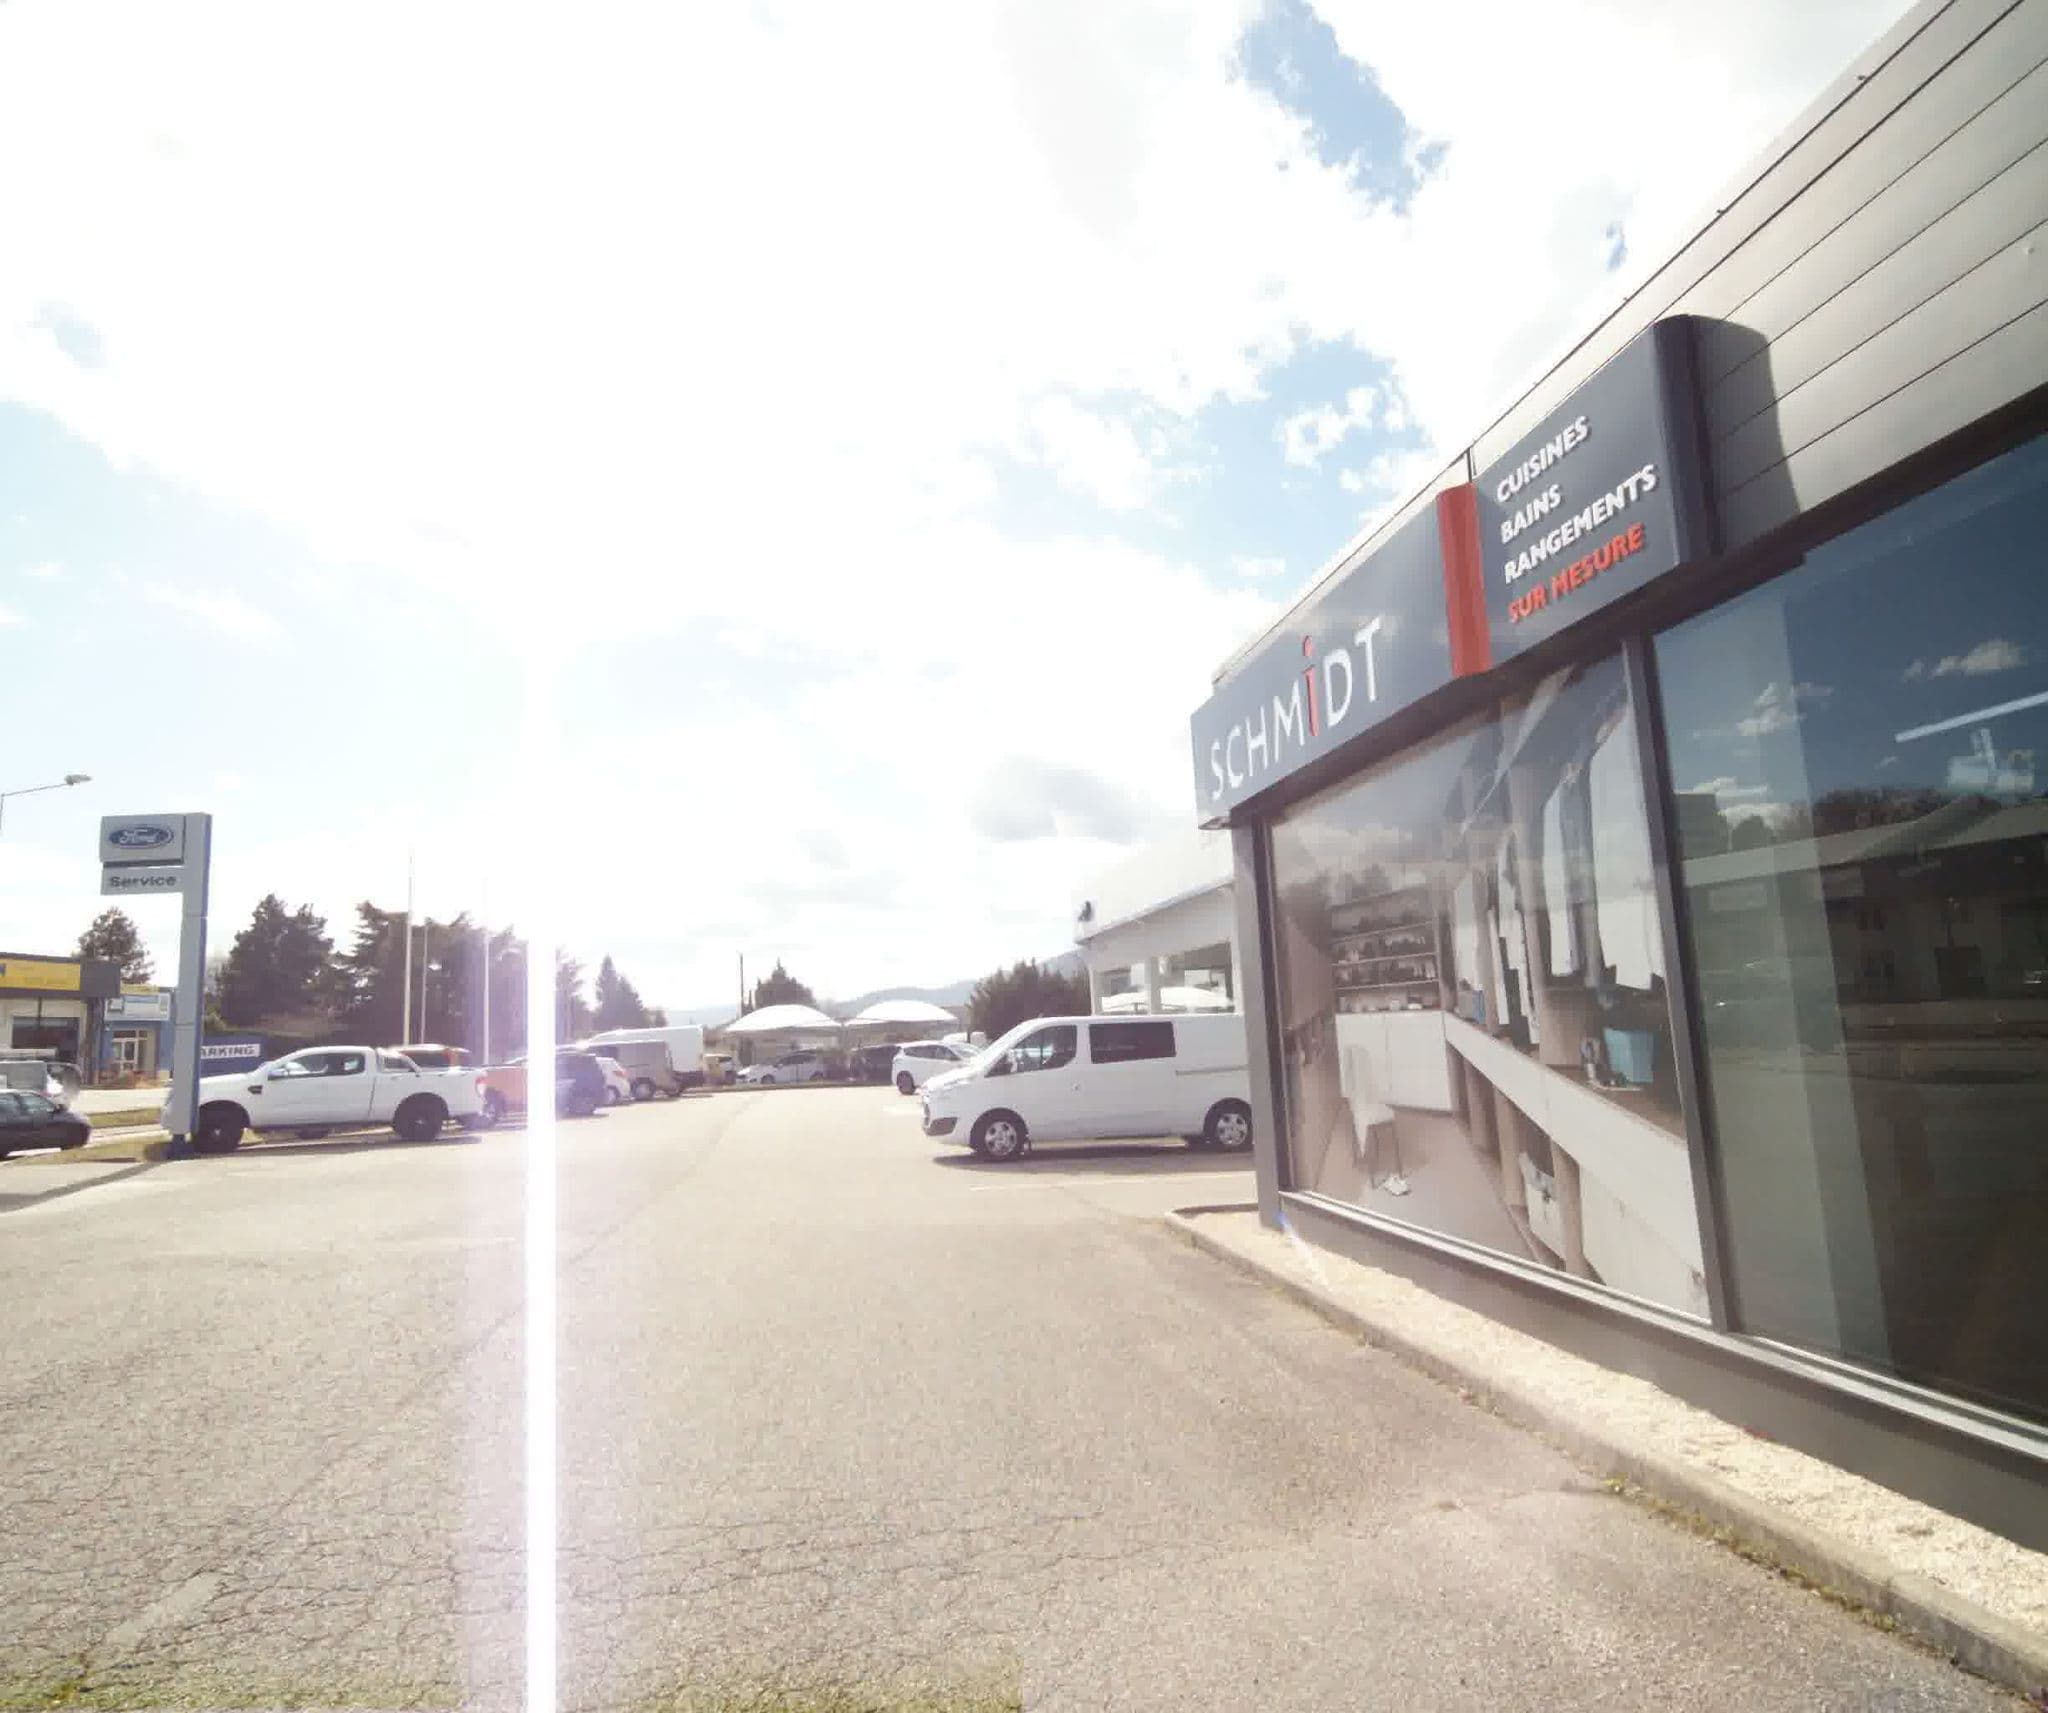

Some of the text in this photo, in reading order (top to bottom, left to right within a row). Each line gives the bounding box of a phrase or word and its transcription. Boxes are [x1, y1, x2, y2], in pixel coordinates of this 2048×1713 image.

[1497, 415, 1590, 503] CUISINES
[1501, 484, 1562, 544] BAINS
[1505, 463, 1658, 584] RANGEMENTS
[1508, 521, 1646, 624] SUR MESURE
[110, 876, 177, 888] Service
[200, 1046, 257, 1057] ARKING
